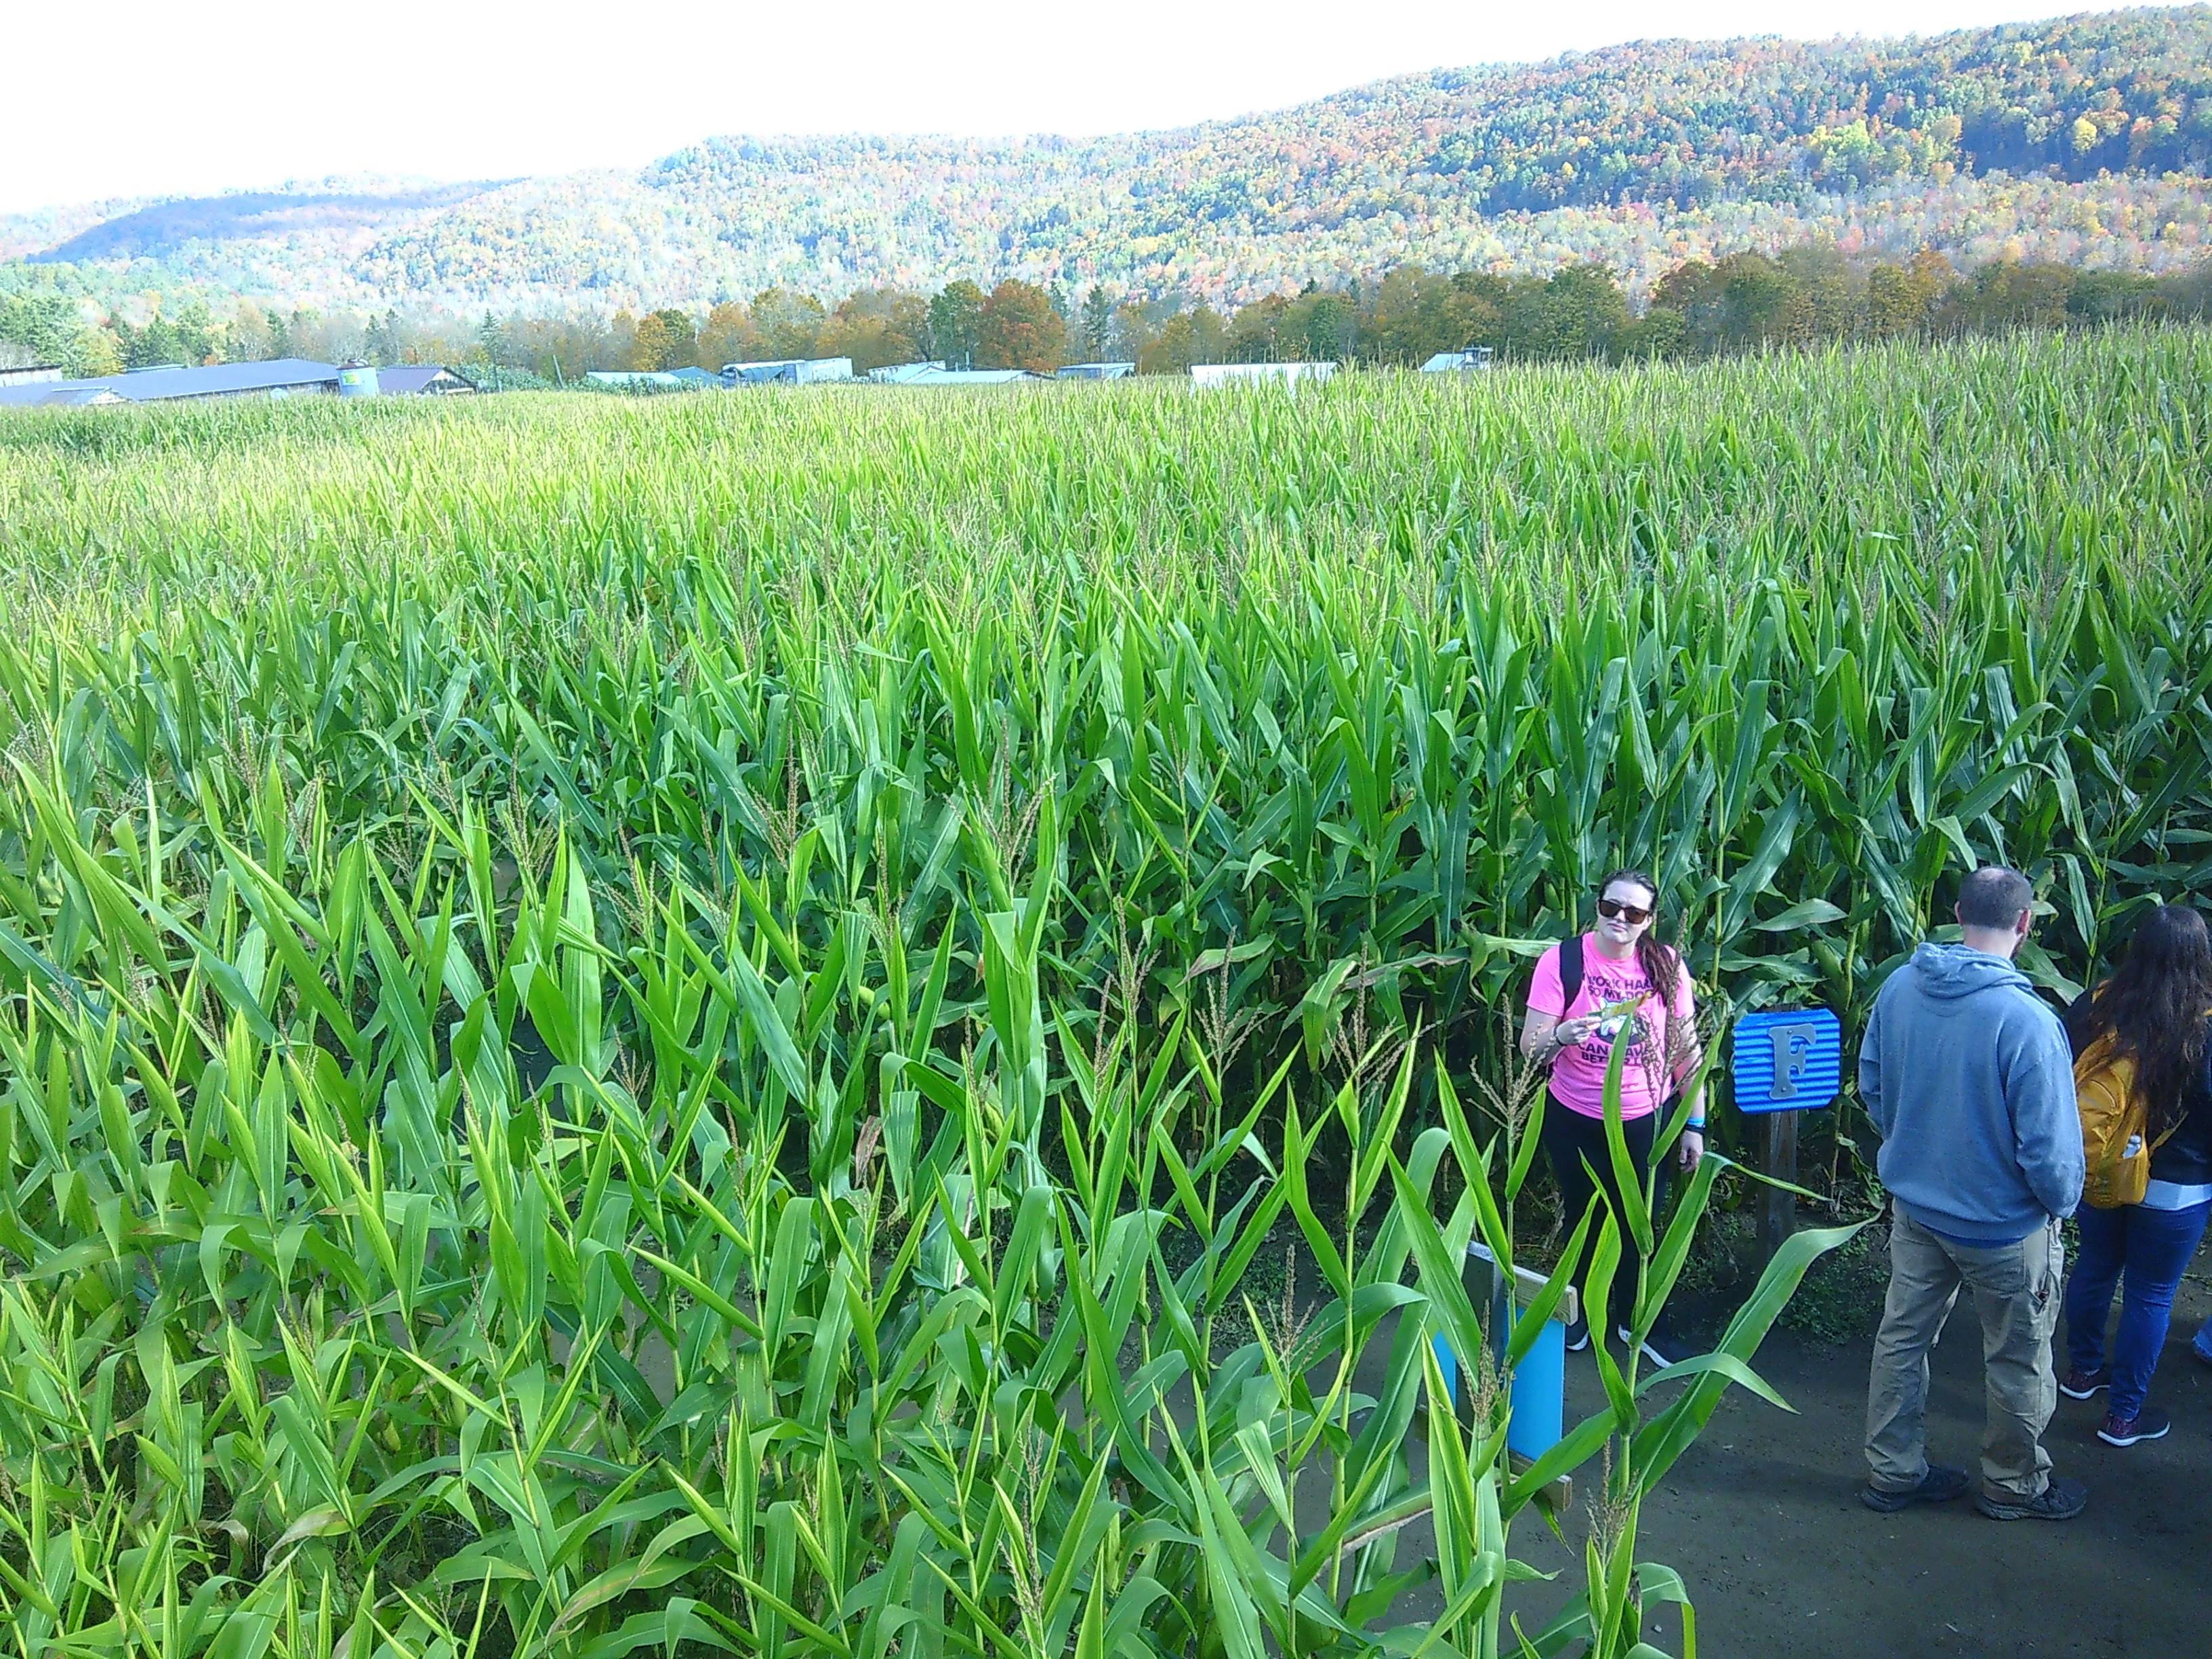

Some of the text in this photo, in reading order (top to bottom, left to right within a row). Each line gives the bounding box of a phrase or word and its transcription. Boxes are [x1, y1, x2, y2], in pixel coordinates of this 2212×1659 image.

[1624, 977, 1652, 989] HAR
[1588, 985, 1601, 997] SO
[1604, 988, 1621, 1000] MY
[1578, 1043, 1608, 1055] CAN
[1768, 1023, 1817, 1100] F
